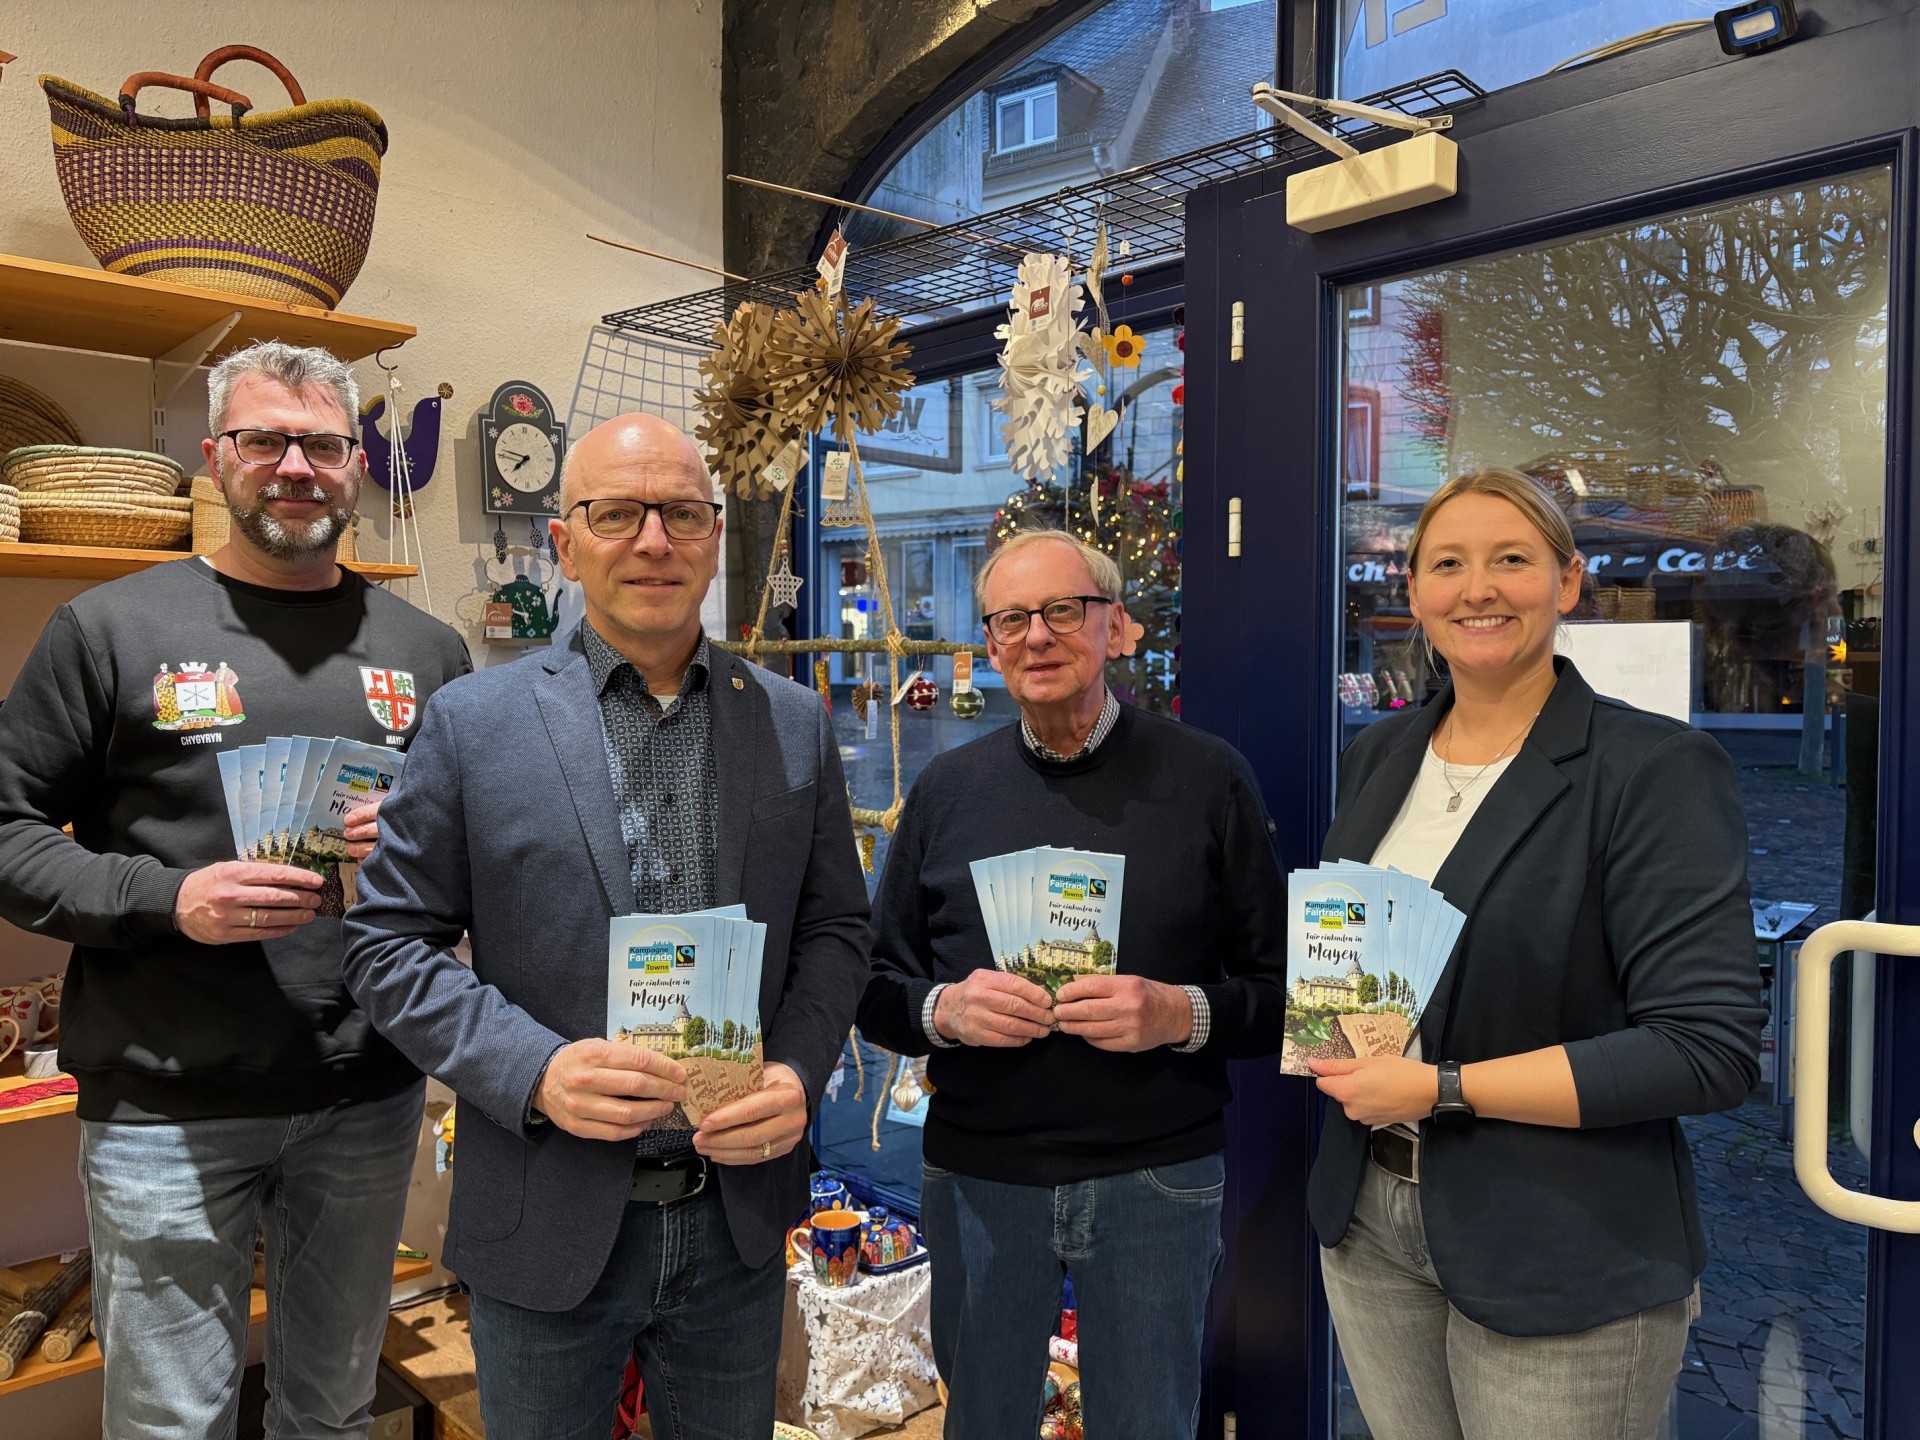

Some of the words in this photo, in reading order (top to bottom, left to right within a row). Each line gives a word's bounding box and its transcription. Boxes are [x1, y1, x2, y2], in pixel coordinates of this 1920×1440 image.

[1346, 560, 1386, 583] ch
[180, 732, 223, 746] CHYGYRYN
[339, 769, 375, 784] Fairtrade
[351, 781, 369, 791] Towns
[1049, 874, 1084, 885] Kampagne
[1049, 880, 1087, 891] Fairtrade
[1063, 890, 1084, 898] Towns
[1048, 901, 1062, 909] Fair
[1094, 906, 1102, 914] in
[1305, 901, 1341, 910] Kampagne
[1305, 908, 1345, 917] Fairtrade
[1049, 910, 1101, 931] Mayen
[1306, 932, 1320, 940] Fair
[1354, 934, 1362, 943] in
[629, 946, 669, 954] Kampagne
[1308, 942, 1363, 965] Mayen
[629, 953, 673, 962] Fairtrade
[629, 979, 645, 988] Fair
[645, 977, 681, 988] einkaufen
[682, 978, 691, 986] in
[631, 988, 691, 1012] Mayen
